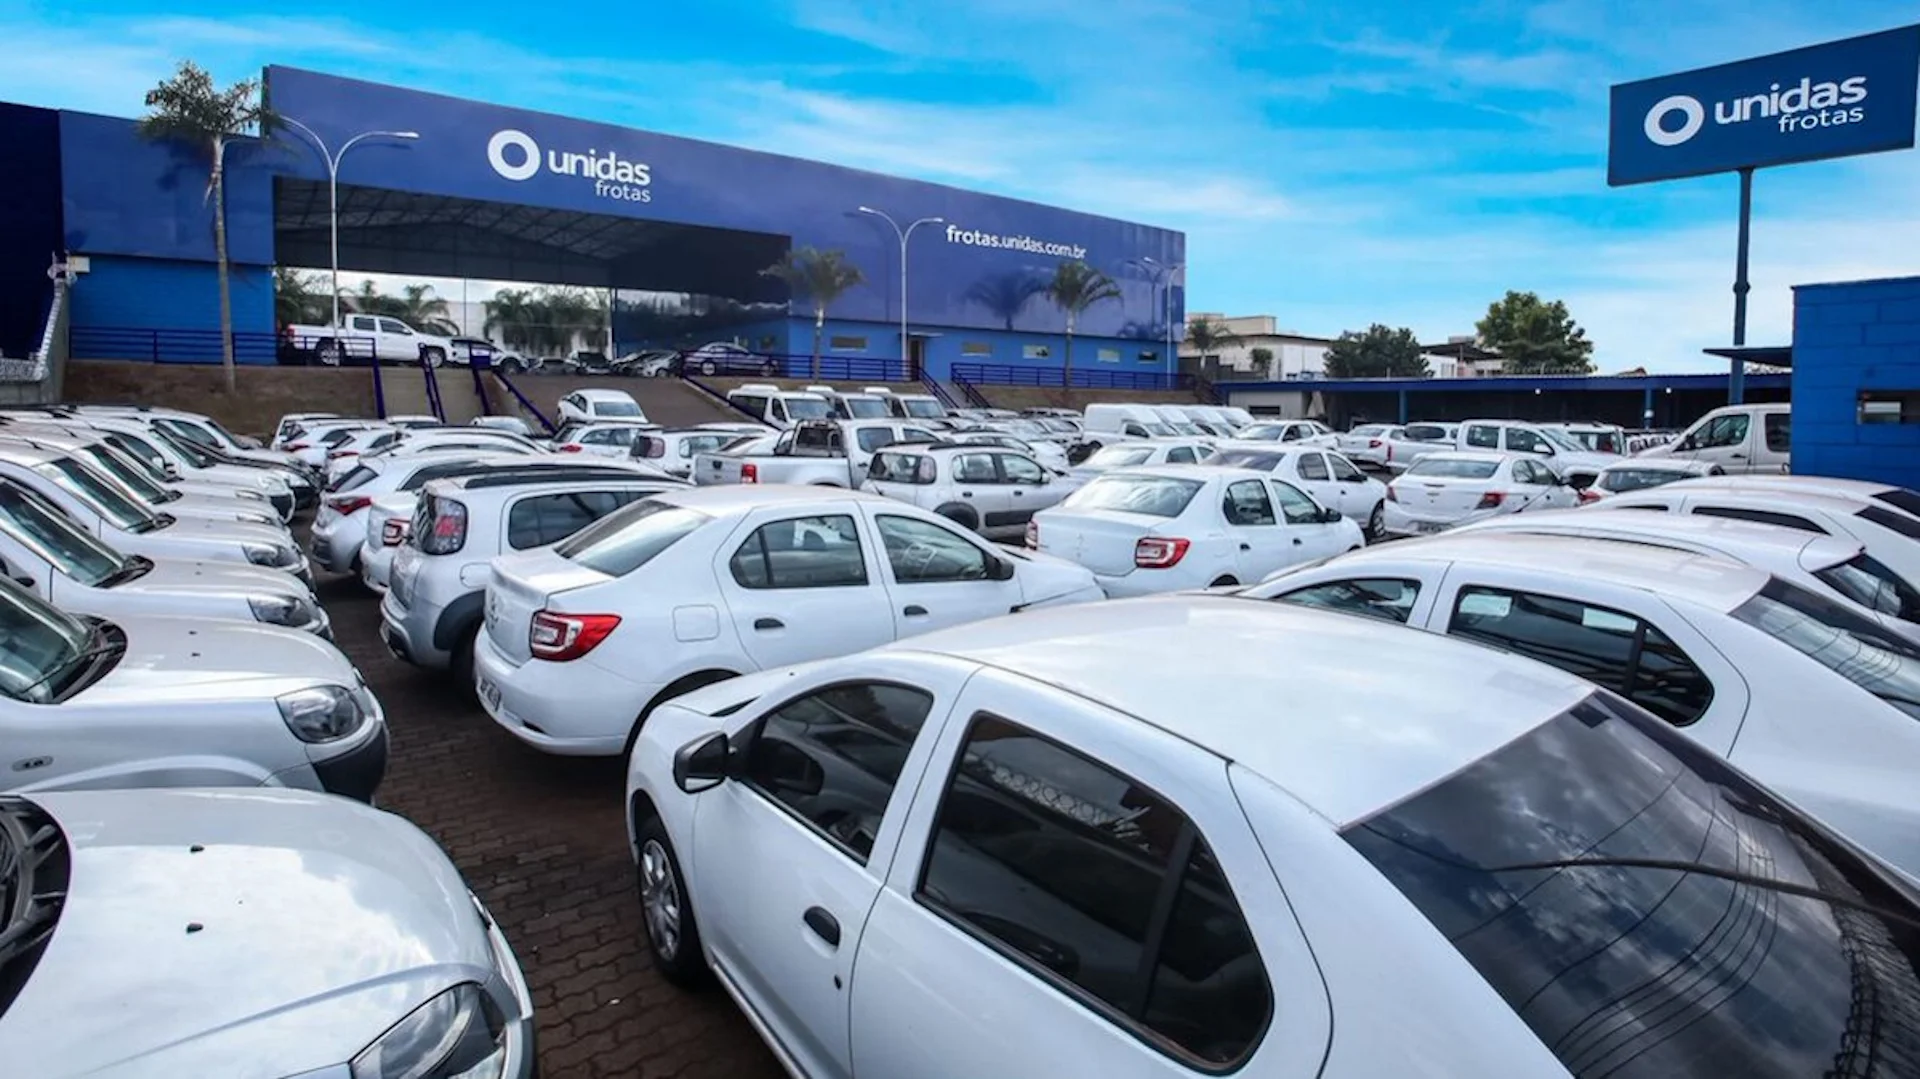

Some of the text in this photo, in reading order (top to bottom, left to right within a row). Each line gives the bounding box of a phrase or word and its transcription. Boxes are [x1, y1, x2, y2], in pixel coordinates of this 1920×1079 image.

[1714, 76, 1868, 125] unidas
[1778, 107, 1864, 133] frotas
[548, 148, 651, 186] unidas
[595, 179, 651, 203] frotas
[945, 224, 1087, 259] frotas.unidas.com.br
